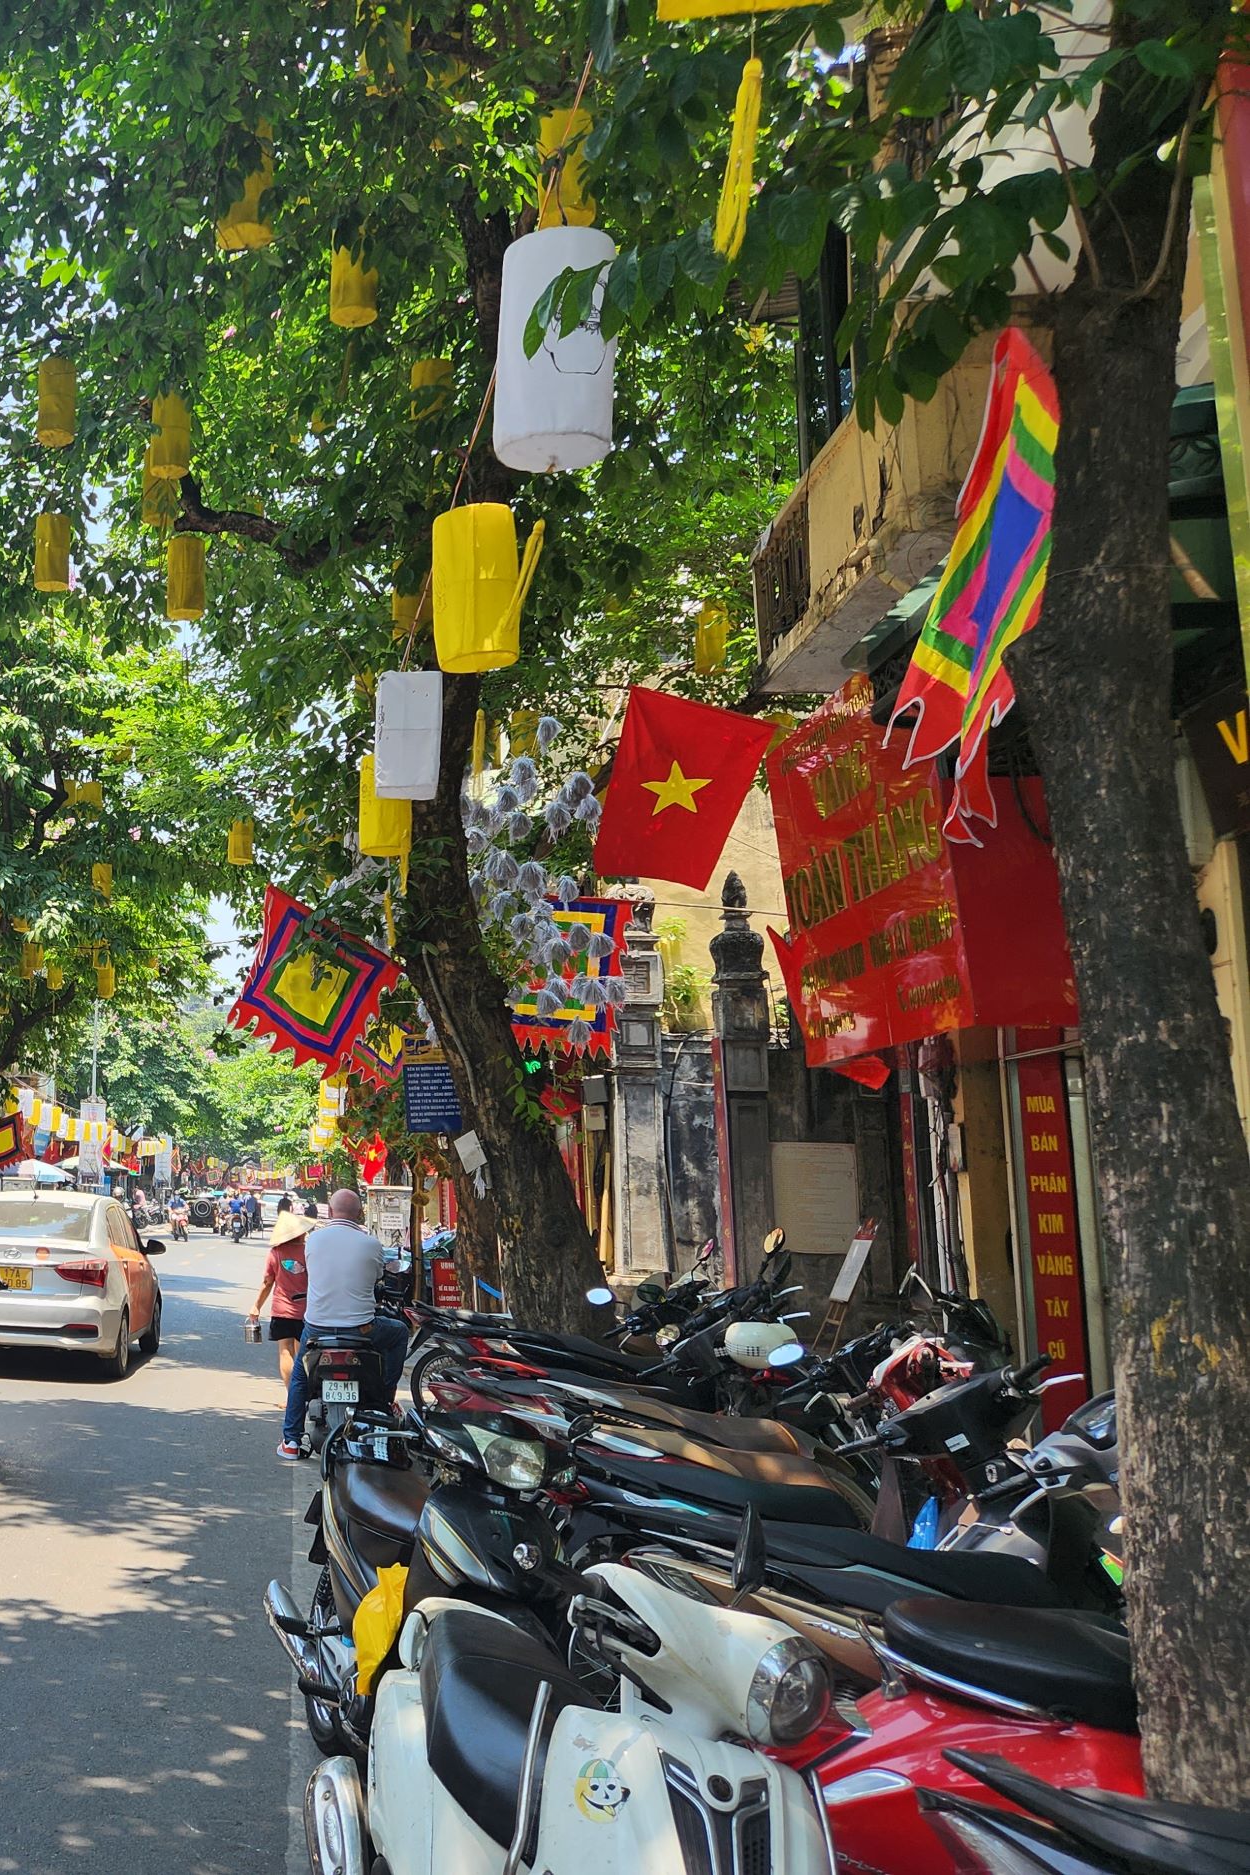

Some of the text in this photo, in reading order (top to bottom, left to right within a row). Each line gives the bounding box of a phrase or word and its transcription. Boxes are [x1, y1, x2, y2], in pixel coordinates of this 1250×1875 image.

[784, 844, 849, 936] TOÀN
[1027, 1095, 1055, 1113] MUA
[1031, 1132, 1058, 1152] BÁN
[1030, 1172, 1067, 1193] PHÂN
[1038, 1213, 1064, 1234] KIM
[5, 1268, 20, 1278] 17A
[1037, 1252, 1073, 1276] VÀNG
[1044, 1298, 1069, 1317] TÂY
[328, 1382, 354, 1391] 29-M1
[325, 1392, 357, 1401] 849.36
